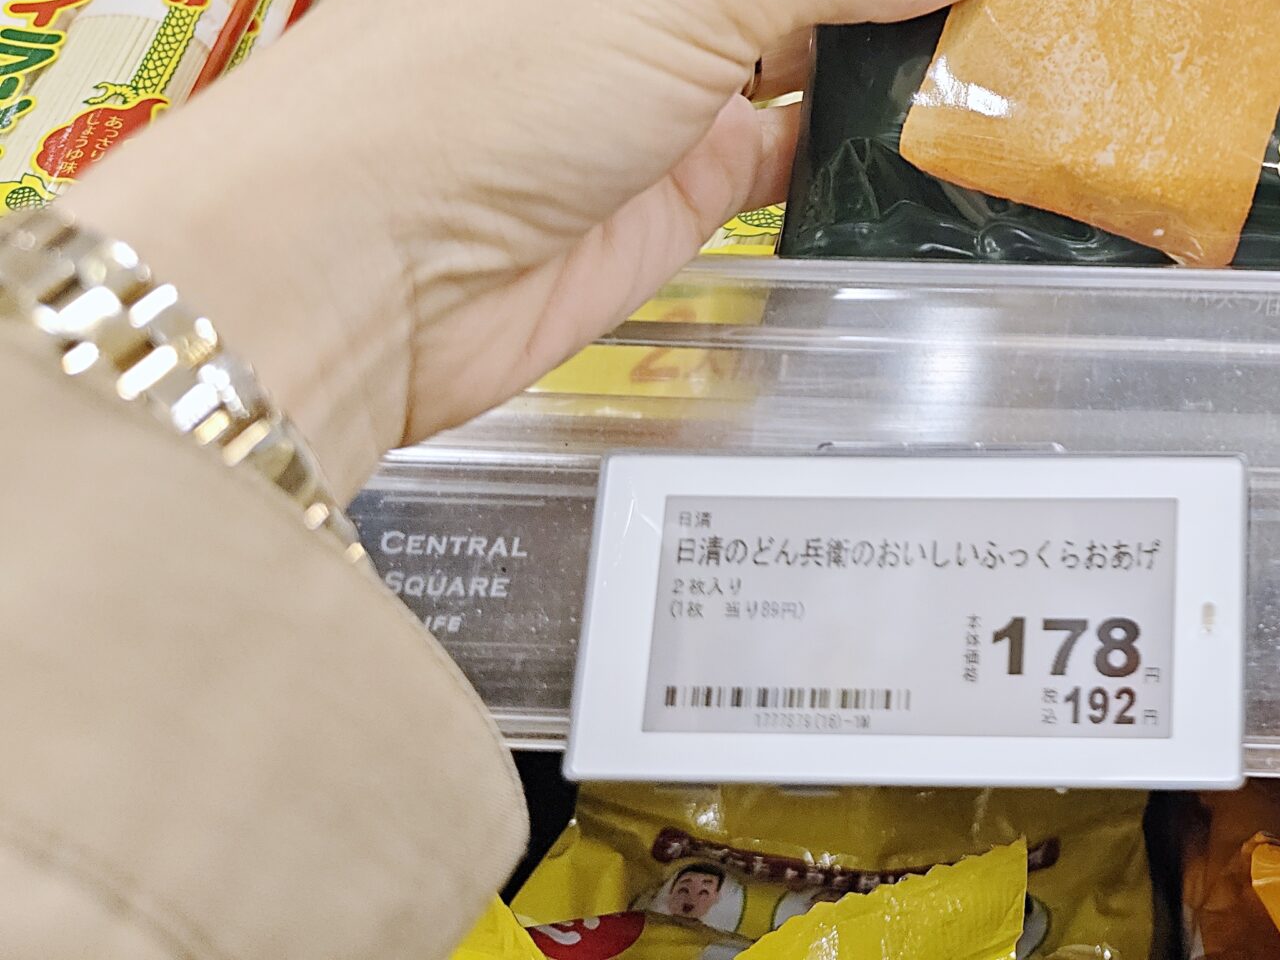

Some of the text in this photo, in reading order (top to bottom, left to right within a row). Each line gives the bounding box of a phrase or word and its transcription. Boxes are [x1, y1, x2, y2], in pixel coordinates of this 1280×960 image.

[678, 510, 713, 529] 日清
[380, 530, 528, 557] CENTRAL
[675, 535, 1162, 571] 日清のどん兵衛のおいしいふっくらおあげ
[384, 570, 511, 598] SQUARE
[992, 616, 1141, 678] 178
[1064, 686, 1136, 725] 192
